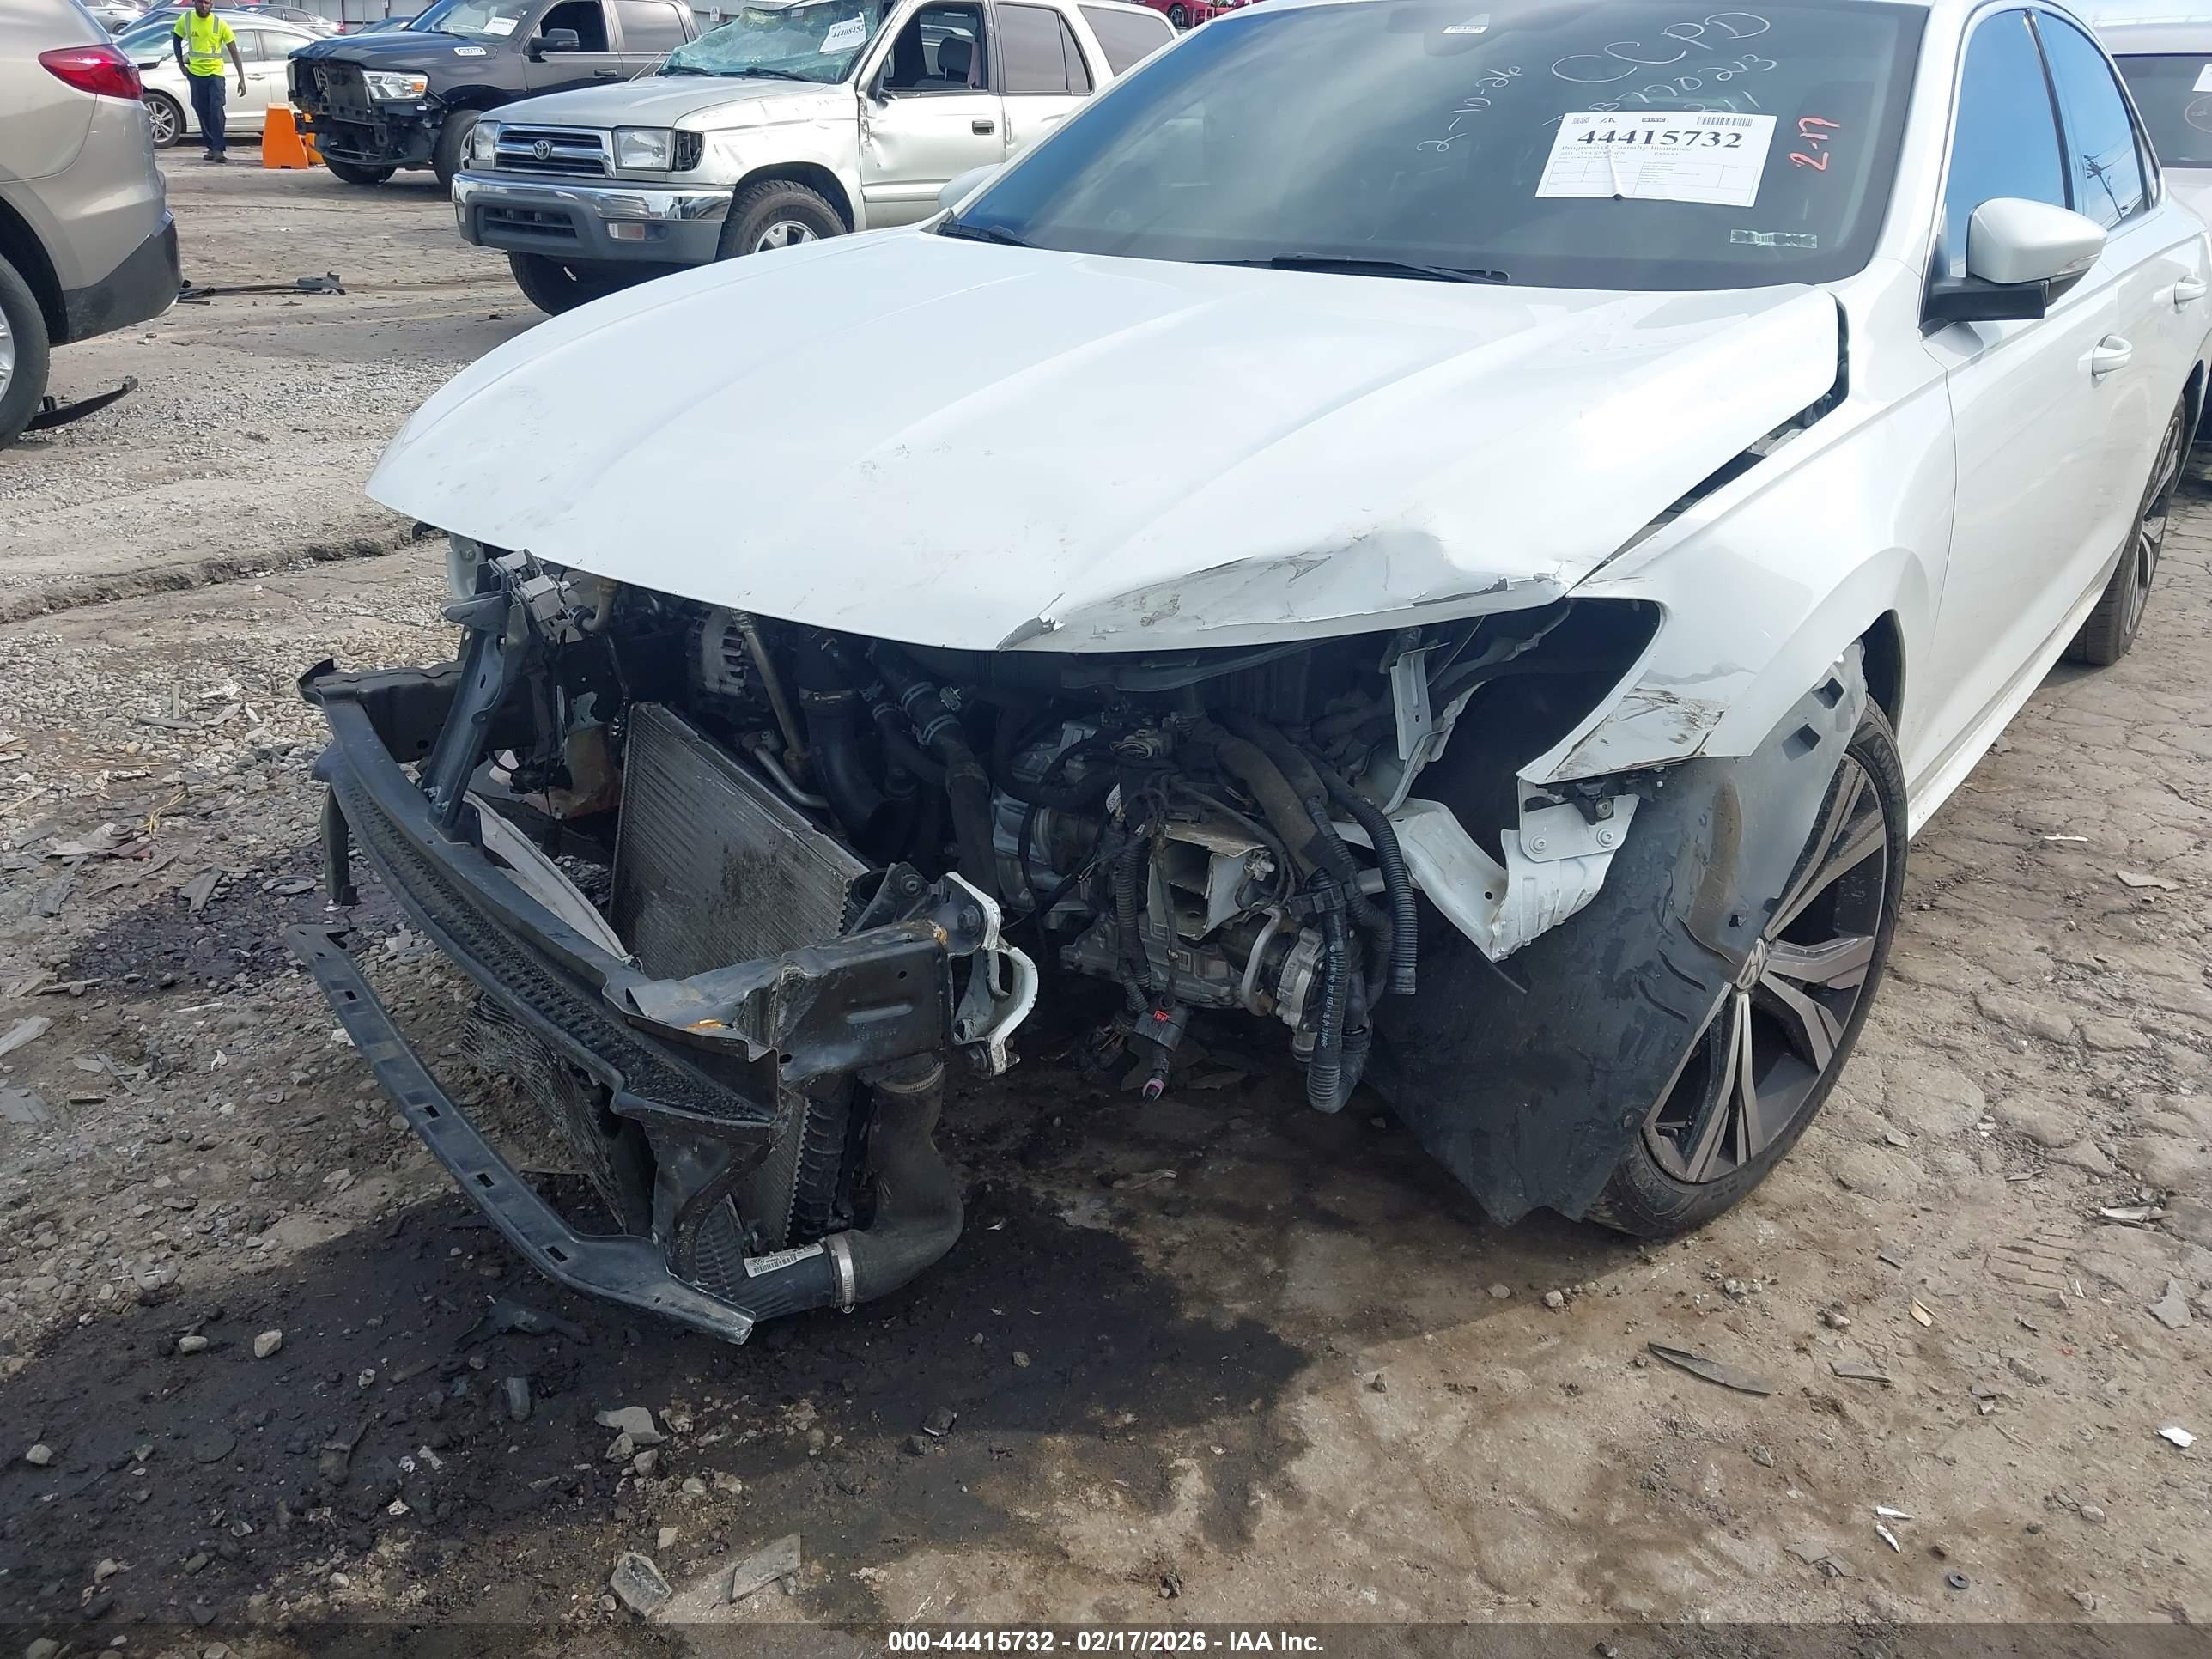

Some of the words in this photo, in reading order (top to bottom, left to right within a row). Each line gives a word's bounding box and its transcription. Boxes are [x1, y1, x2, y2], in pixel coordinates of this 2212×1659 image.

[1551, 12, 1771, 83] CCPD
[1577, 129, 1743, 149] 44415732
[1650, 144, 1692, 153] Insurance
